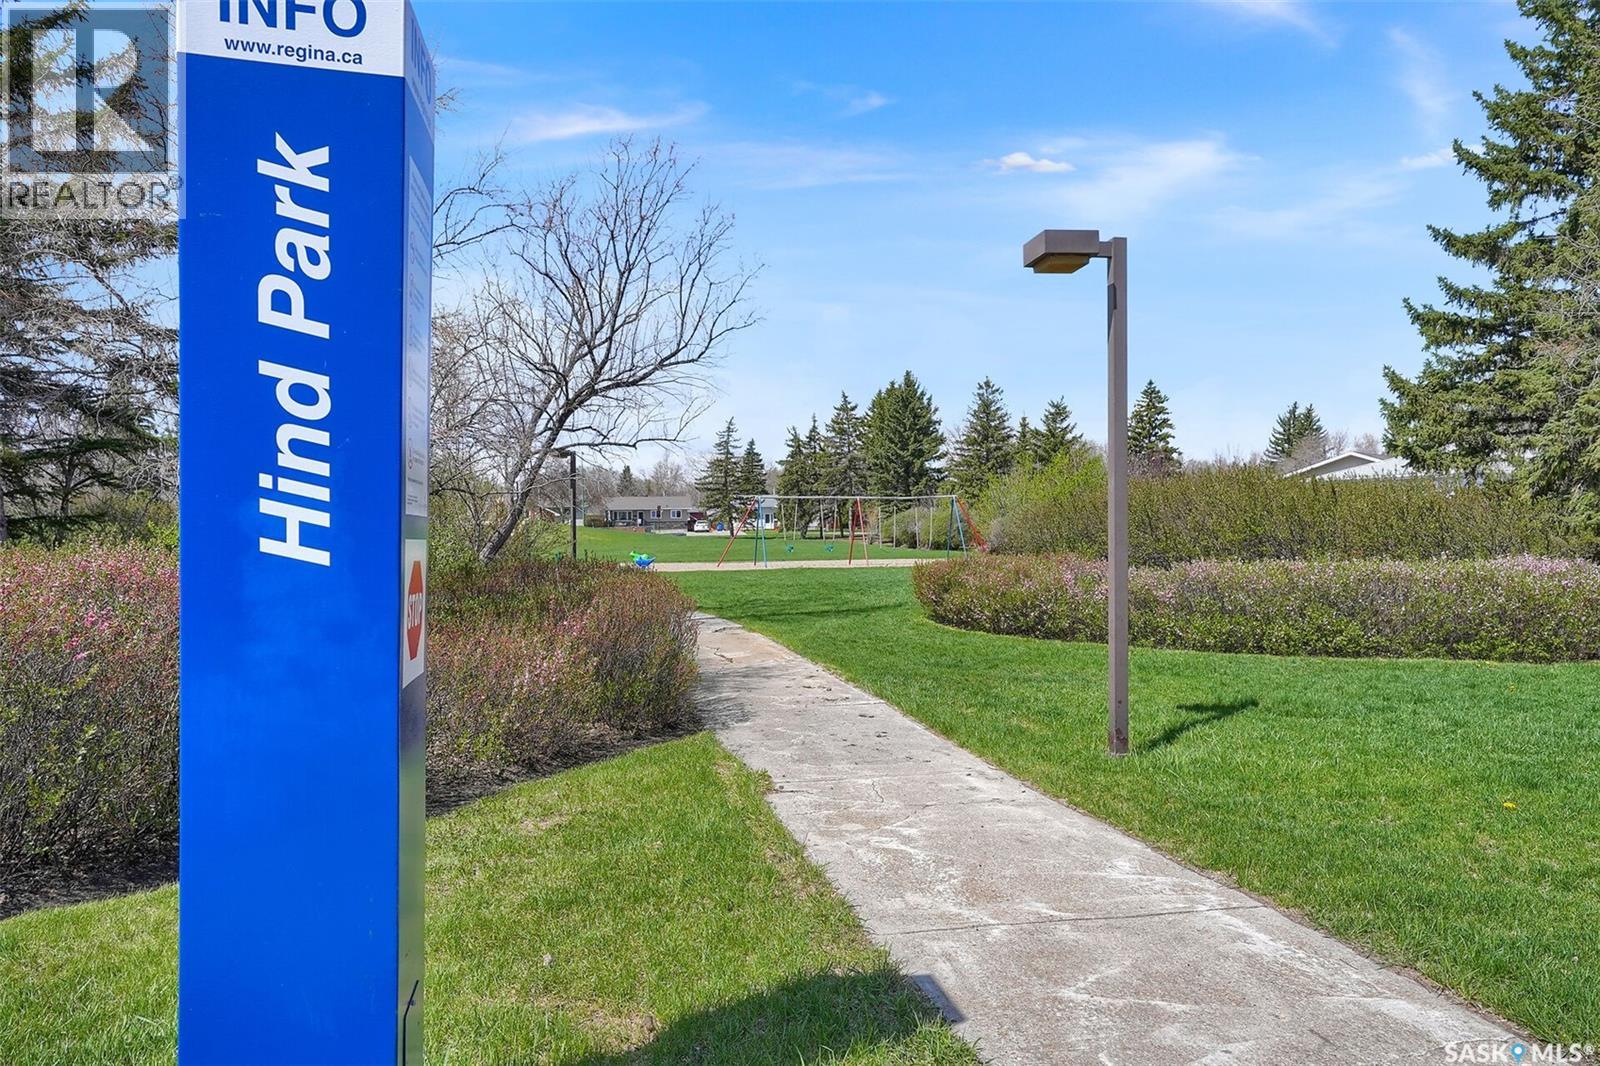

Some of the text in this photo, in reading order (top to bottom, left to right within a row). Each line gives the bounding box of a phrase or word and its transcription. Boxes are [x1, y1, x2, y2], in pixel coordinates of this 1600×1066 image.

[219, 0, 367, 38] INFO
[224, 38, 363, 65] www.regina.ca
[256, 131, 332, 567] Hind Park
[407, 592, 423, 630] STOP
